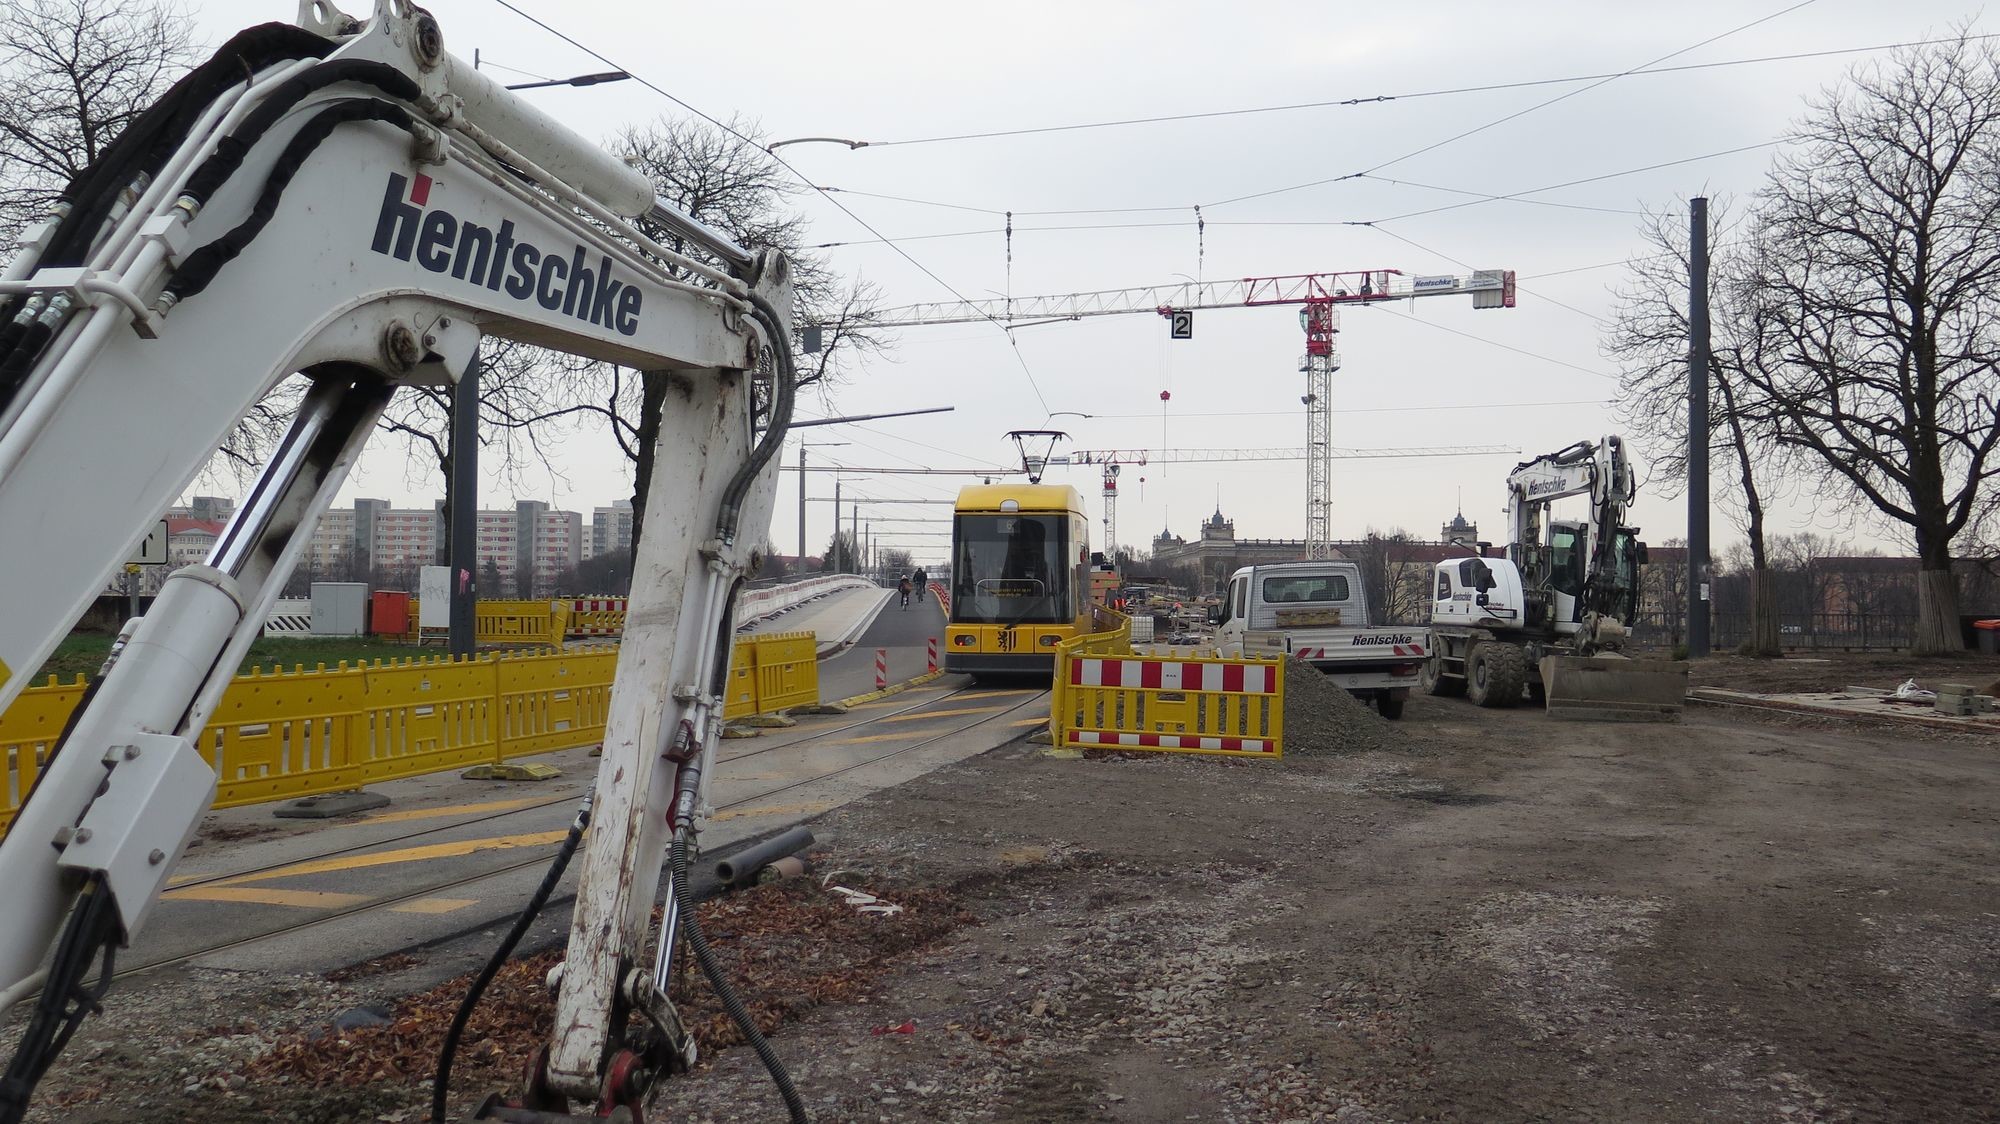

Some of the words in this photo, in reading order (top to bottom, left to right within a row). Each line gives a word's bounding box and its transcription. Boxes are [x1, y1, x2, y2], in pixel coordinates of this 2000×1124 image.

[371, 171, 643, 336] Hentschke
[1176, 316, 1188, 334] 2
[1352, 634, 1412, 646] Hentschke
